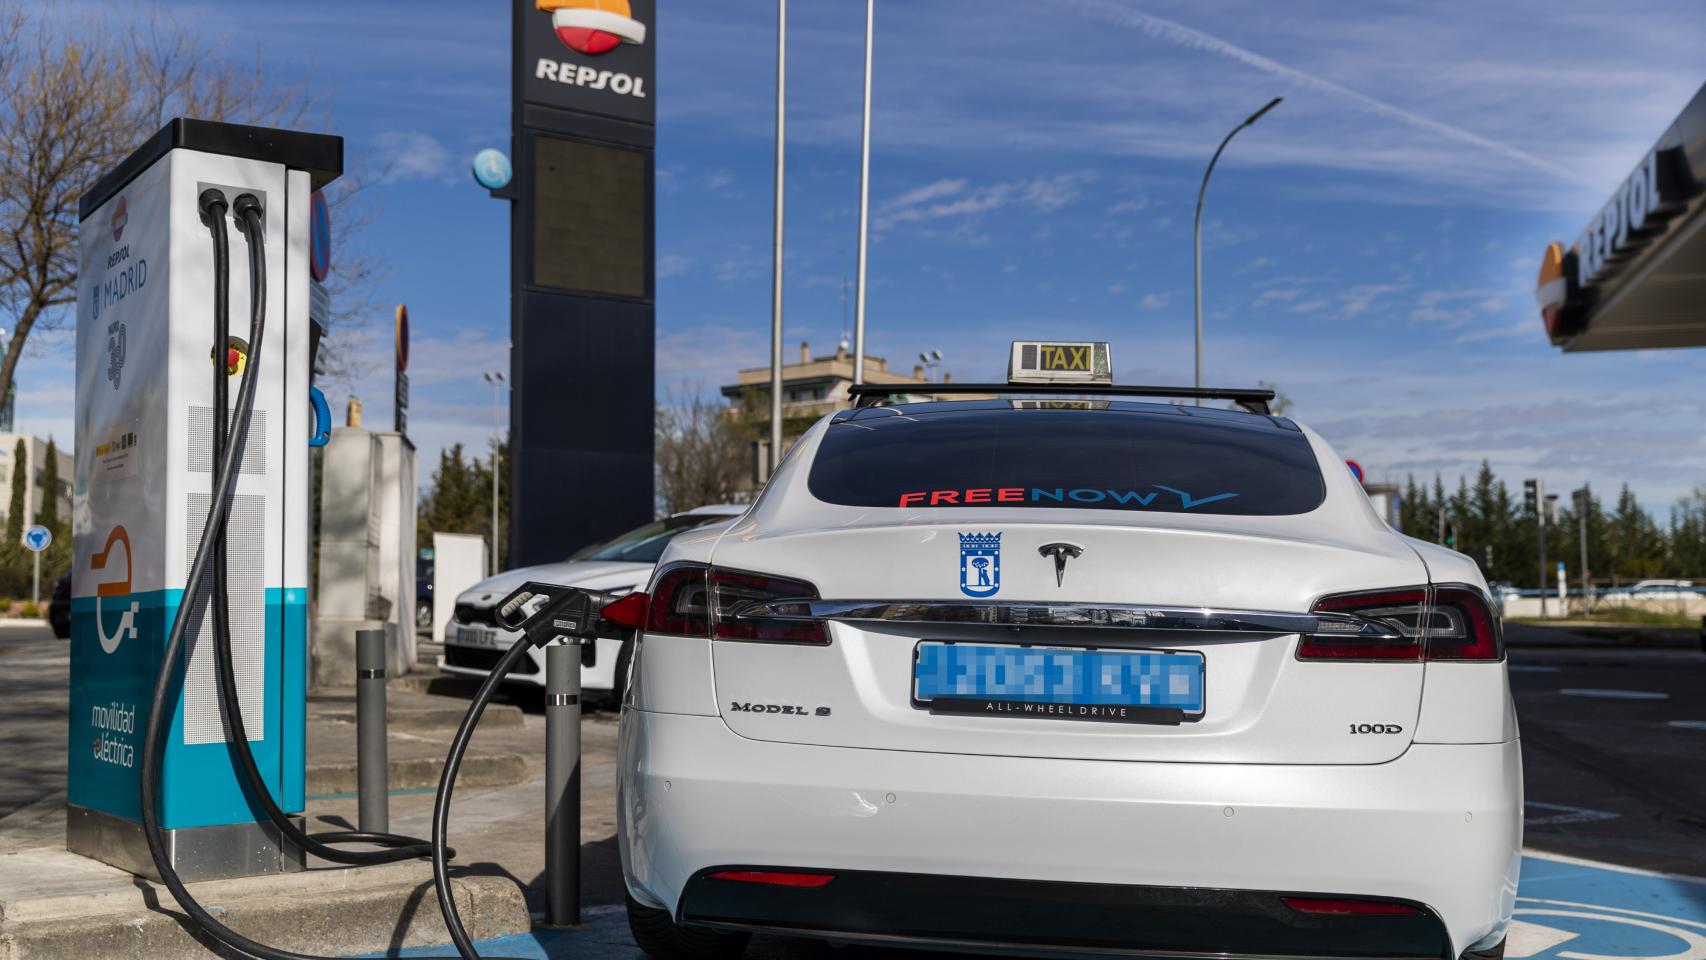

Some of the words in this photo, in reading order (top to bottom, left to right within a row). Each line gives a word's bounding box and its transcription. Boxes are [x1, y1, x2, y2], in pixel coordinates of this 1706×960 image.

[535, 58, 646, 98] REPSOL
[1578, 150, 1661, 288] REPSOL
[107, 244, 130, 270] REPSOL
[104, 259, 147, 309] MADRID
[1041, 346, 1091, 370] TAXI
[91, 701, 135, 734] movilidad
[730, 701, 809, 716] MODEL
[815, 706, 832, 717] S
[1349, 724, 1403, 734] 100D
[93, 732, 134, 768] eléctrica
